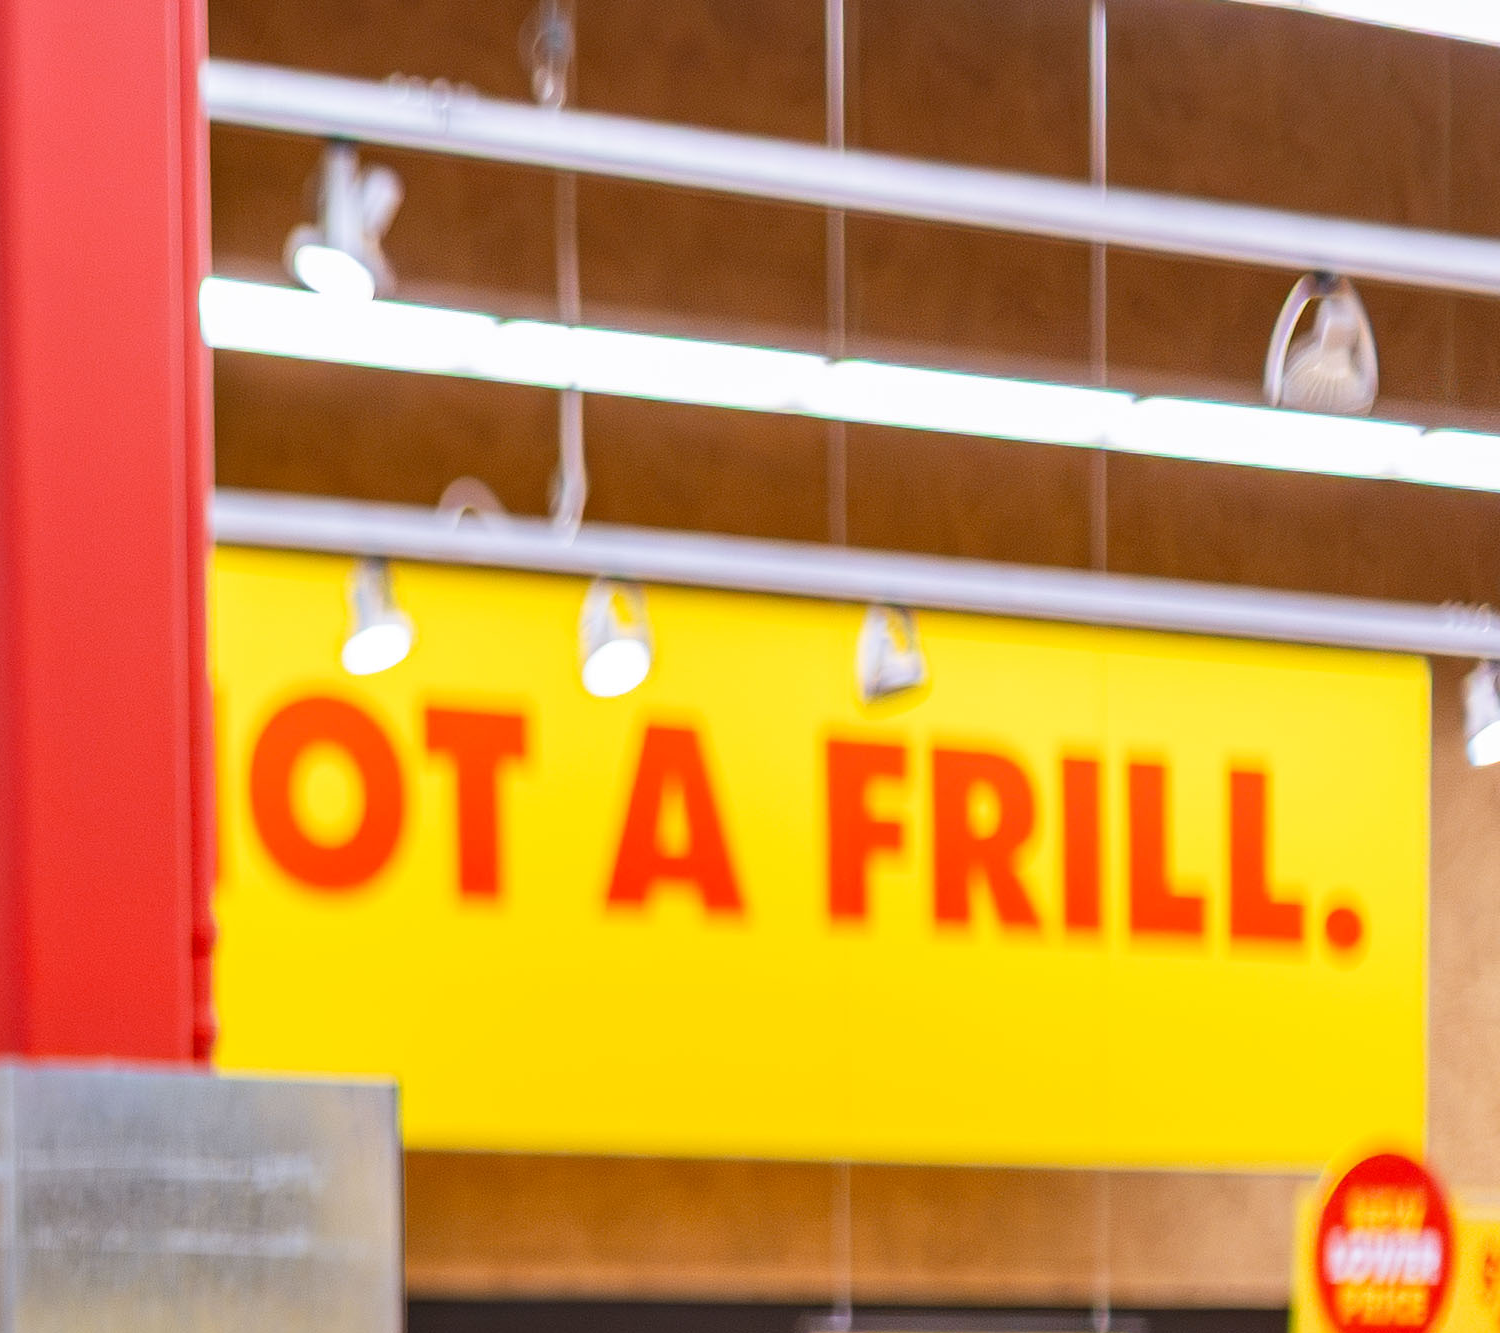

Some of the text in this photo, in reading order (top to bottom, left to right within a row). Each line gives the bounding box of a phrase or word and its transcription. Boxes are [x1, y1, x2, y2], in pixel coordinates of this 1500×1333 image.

[213, 691, 528, 906] OT
[604, 721, 749, 914] A
[825, 736, 1364, 957] FRILL.
